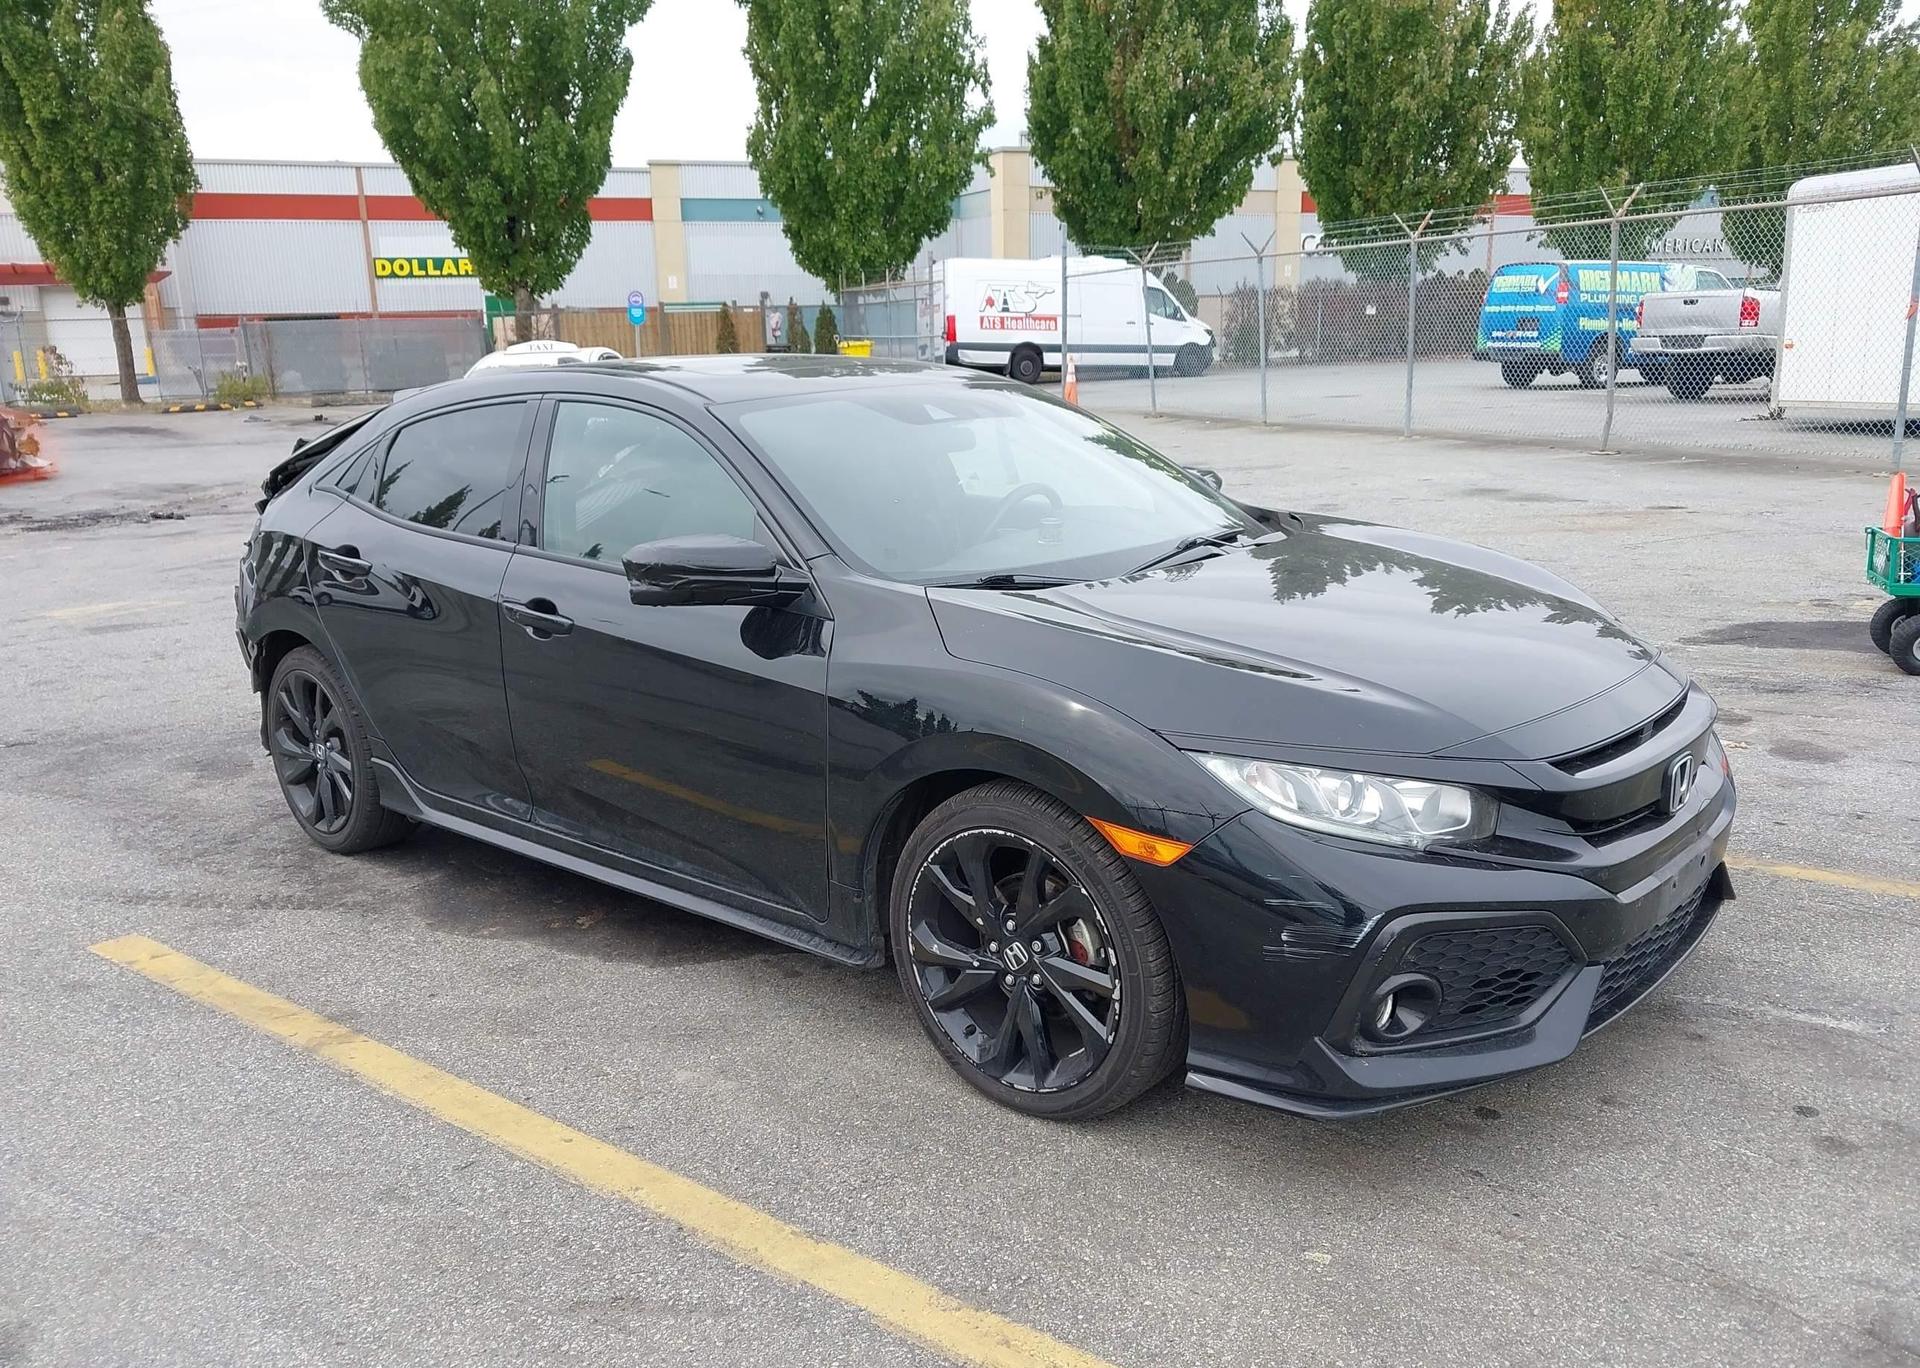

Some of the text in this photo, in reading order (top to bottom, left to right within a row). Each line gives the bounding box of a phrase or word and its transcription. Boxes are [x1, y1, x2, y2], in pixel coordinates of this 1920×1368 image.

[1648, 238, 1726, 253] MERICAN
[374, 258, 476, 277] DOLLAR
[1580, 292, 1638, 304] PLUMING
[982, 316, 1056, 330] ATS Healthcare
[1579, 317, 1619, 332] Plumbig
[529, 343, 553, 351] TAXI
